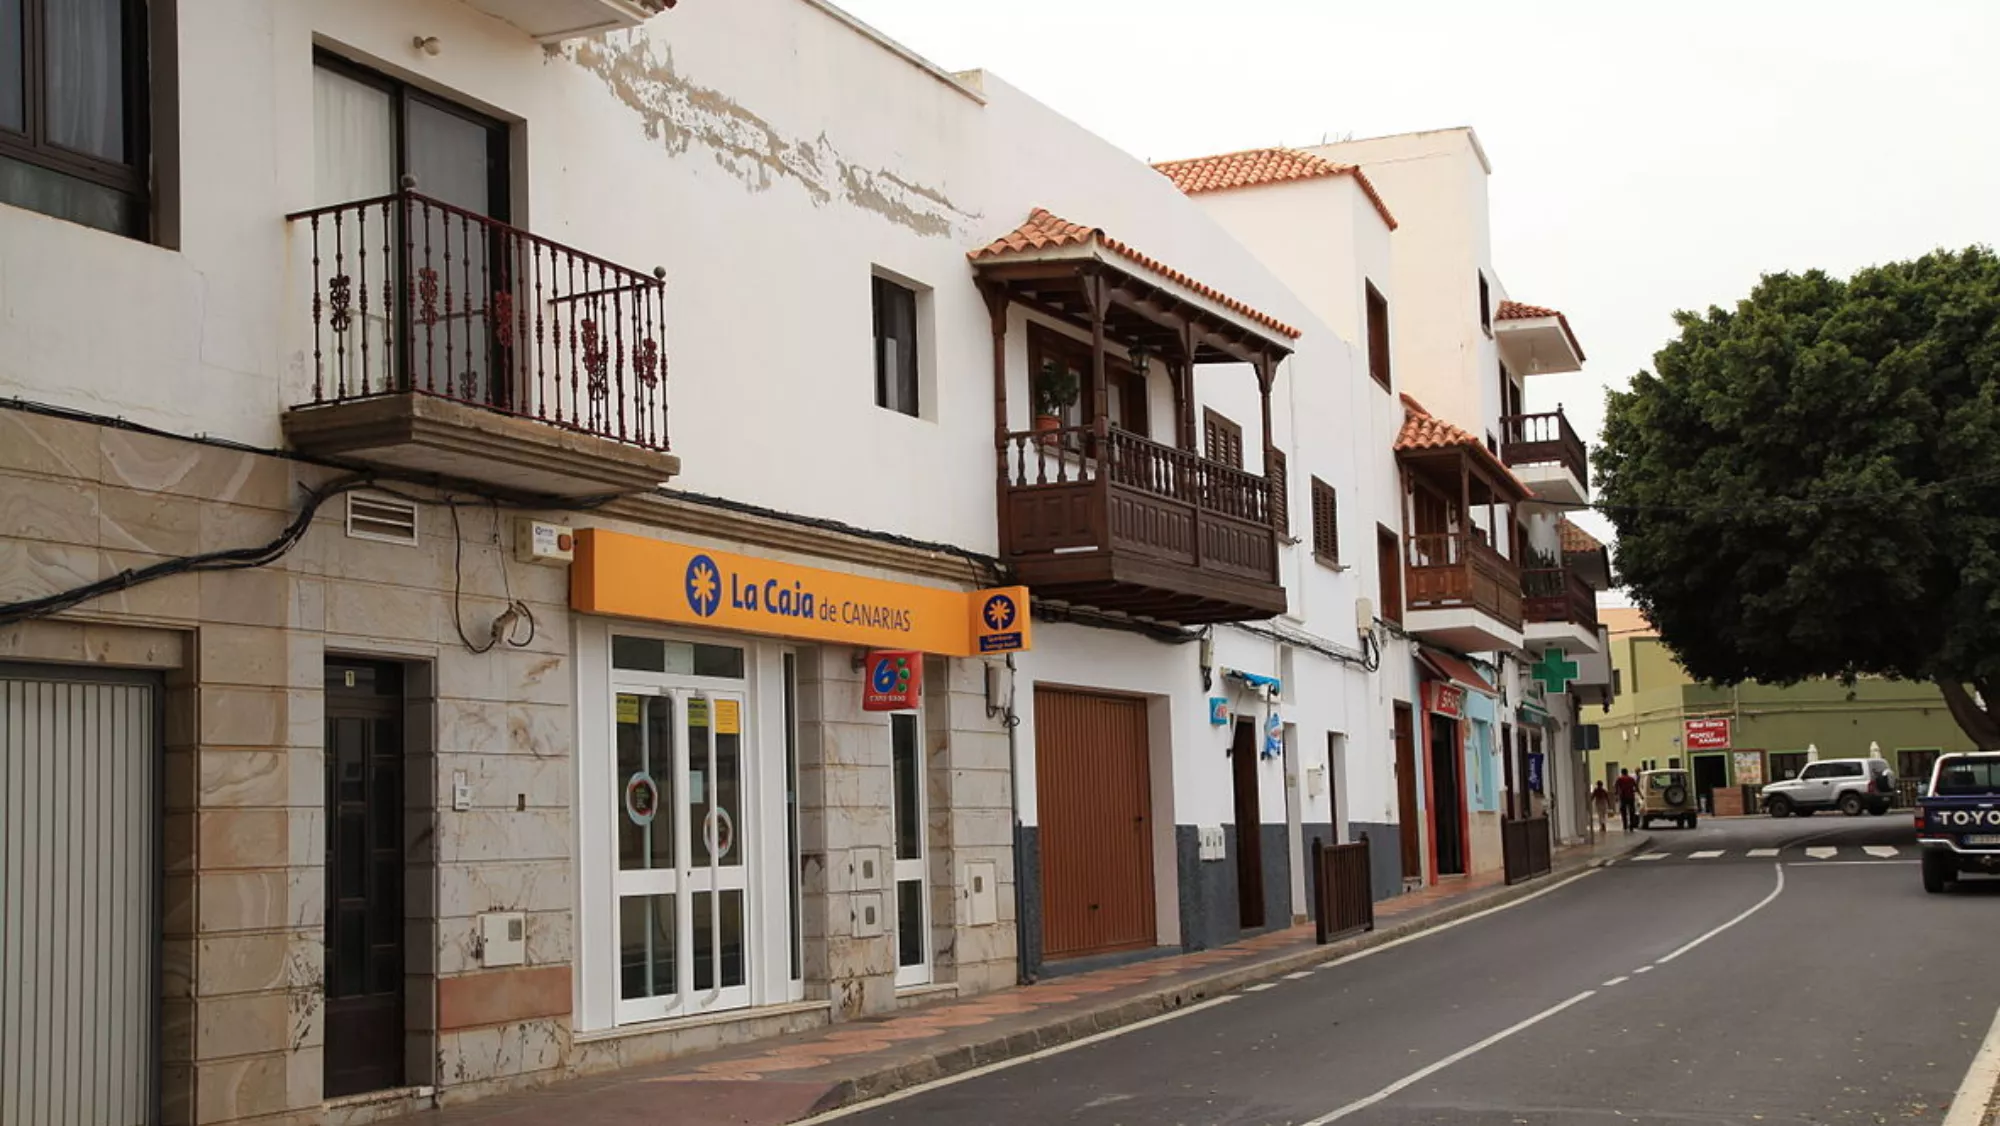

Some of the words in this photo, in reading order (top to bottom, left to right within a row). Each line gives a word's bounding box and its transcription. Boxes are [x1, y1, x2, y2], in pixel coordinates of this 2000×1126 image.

[731, 572, 758, 611] La
[763, 578, 815, 620] Caja
[819, 596, 837, 622] de
[841, 600, 911, 633] CANARIAS
[1938, 810, 2000, 825] TOYO
